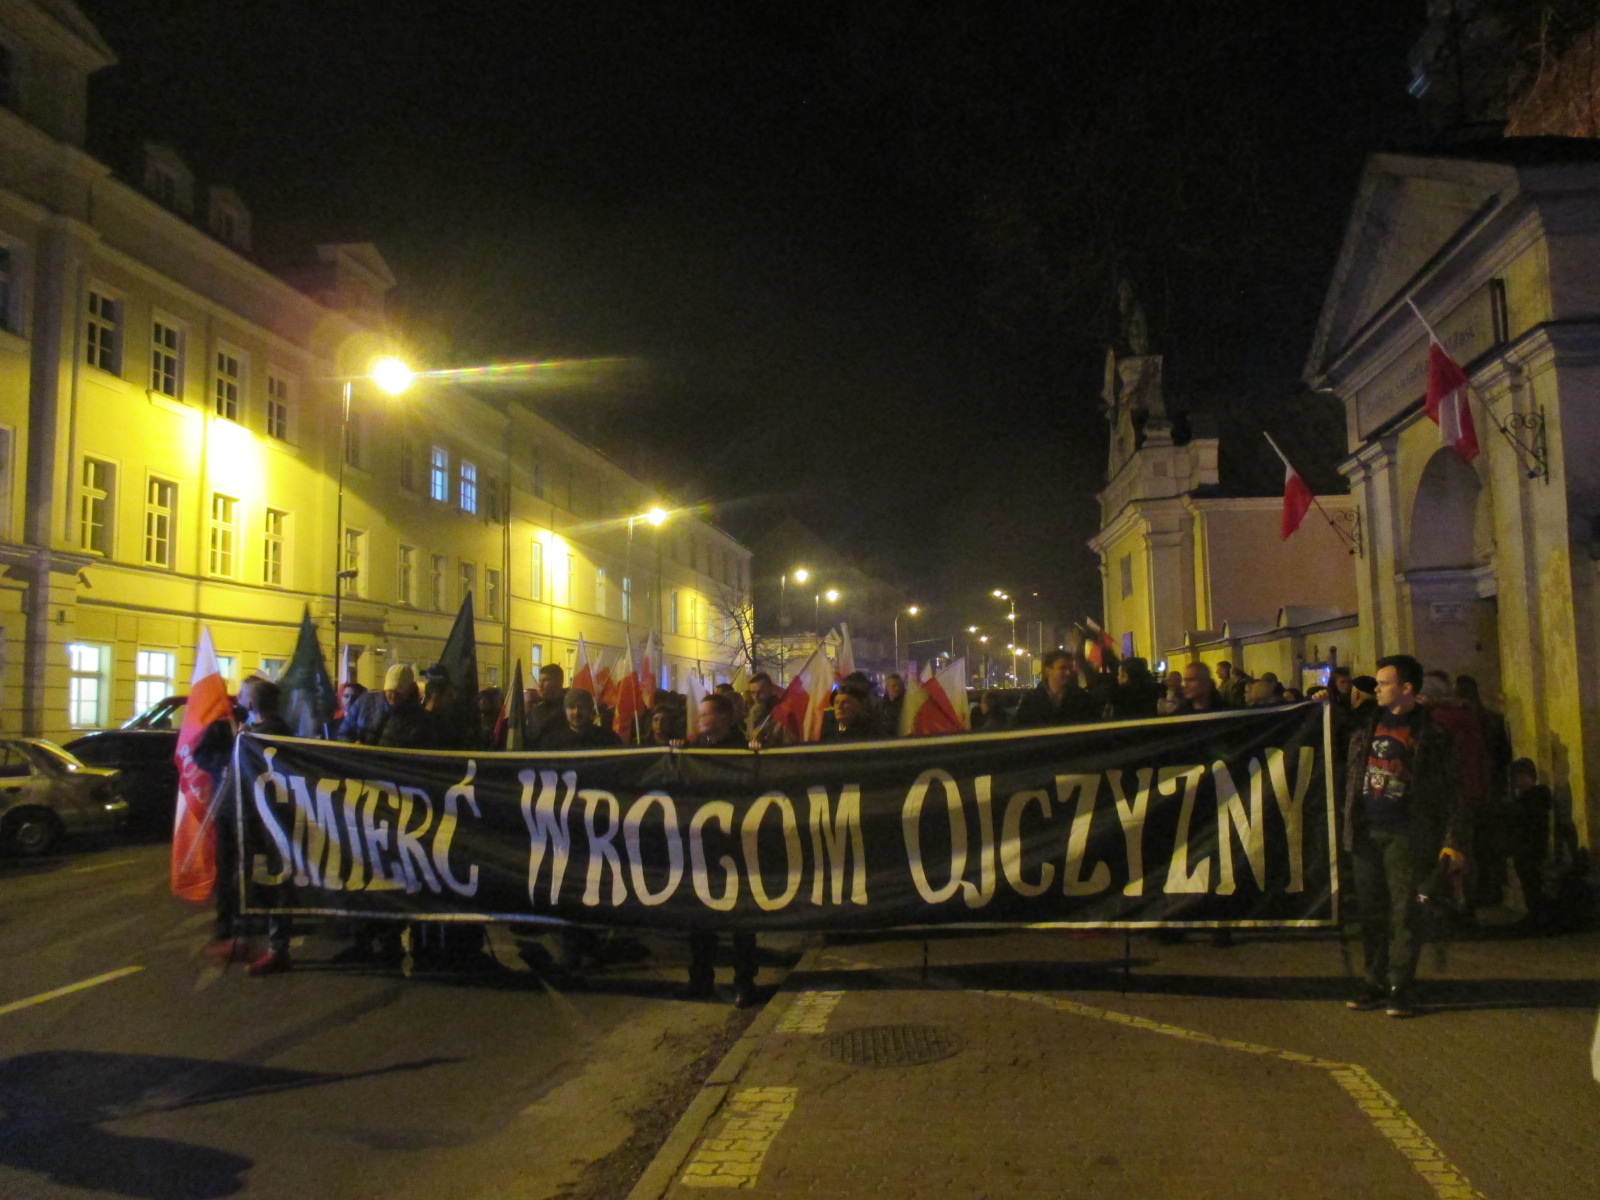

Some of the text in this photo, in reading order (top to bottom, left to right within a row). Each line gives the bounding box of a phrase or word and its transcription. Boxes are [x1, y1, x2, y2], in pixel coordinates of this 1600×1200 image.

[251, 746, 1314, 912] ŚMIERĆ WROGOM OJCZYZNY
